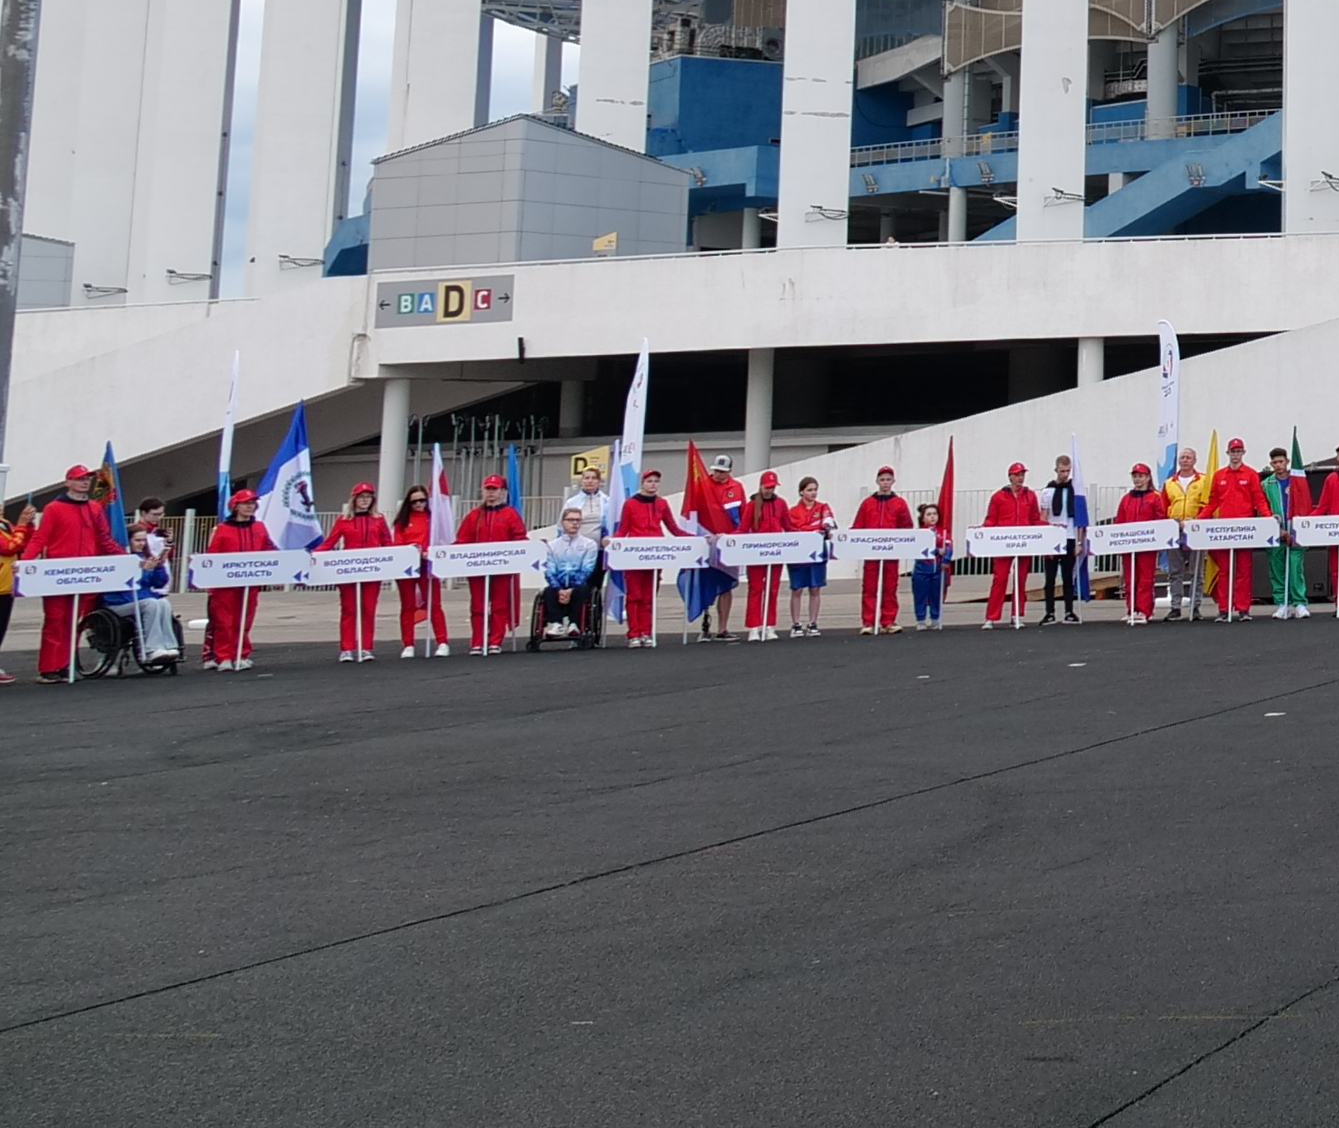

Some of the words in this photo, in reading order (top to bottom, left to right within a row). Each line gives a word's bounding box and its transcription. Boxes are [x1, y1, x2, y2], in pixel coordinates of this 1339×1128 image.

[401, 296, 412, 312] B
[418, 295, 433, 312] A
[443, 285, 465, 318] D
[477, 291, 489, 309] C
[1205, 525, 1257, 534] РЕСПУБЛИКА
[850, 535, 916, 544] КРАСНОЯРСКИЙ
[1209, 534, 1254, 542] ТАТАРСТАН
[623, 544, 692, 553] АРХАНГЕЛЬСКАЯ
[742, 540, 799, 549] ПРИМОРСКИЙ
[871, 543, 894, 552] КРАЙ
[450, 549, 526, 560] ВЛАДИМИРСКАЯ
[638, 552, 677, 561] ОБЛАСТЬ
[759, 548, 782, 557] КРАЙ
[222, 560, 279, 569] ИРКУТСКАЯ
[323, 556, 394, 567] ВОЛОГОДСКАЯ
[466, 558, 510, 567] ОБЛАСТЬ
[44, 565, 116, 576] КЕМЕРОВСКАЯ
[227, 569, 272, 578] ОБЛАСТЬ
[336, 566, 381, 575] ОБЛАСТЬ
[56, 575, 102, 585] ОБЛАСТЬ
